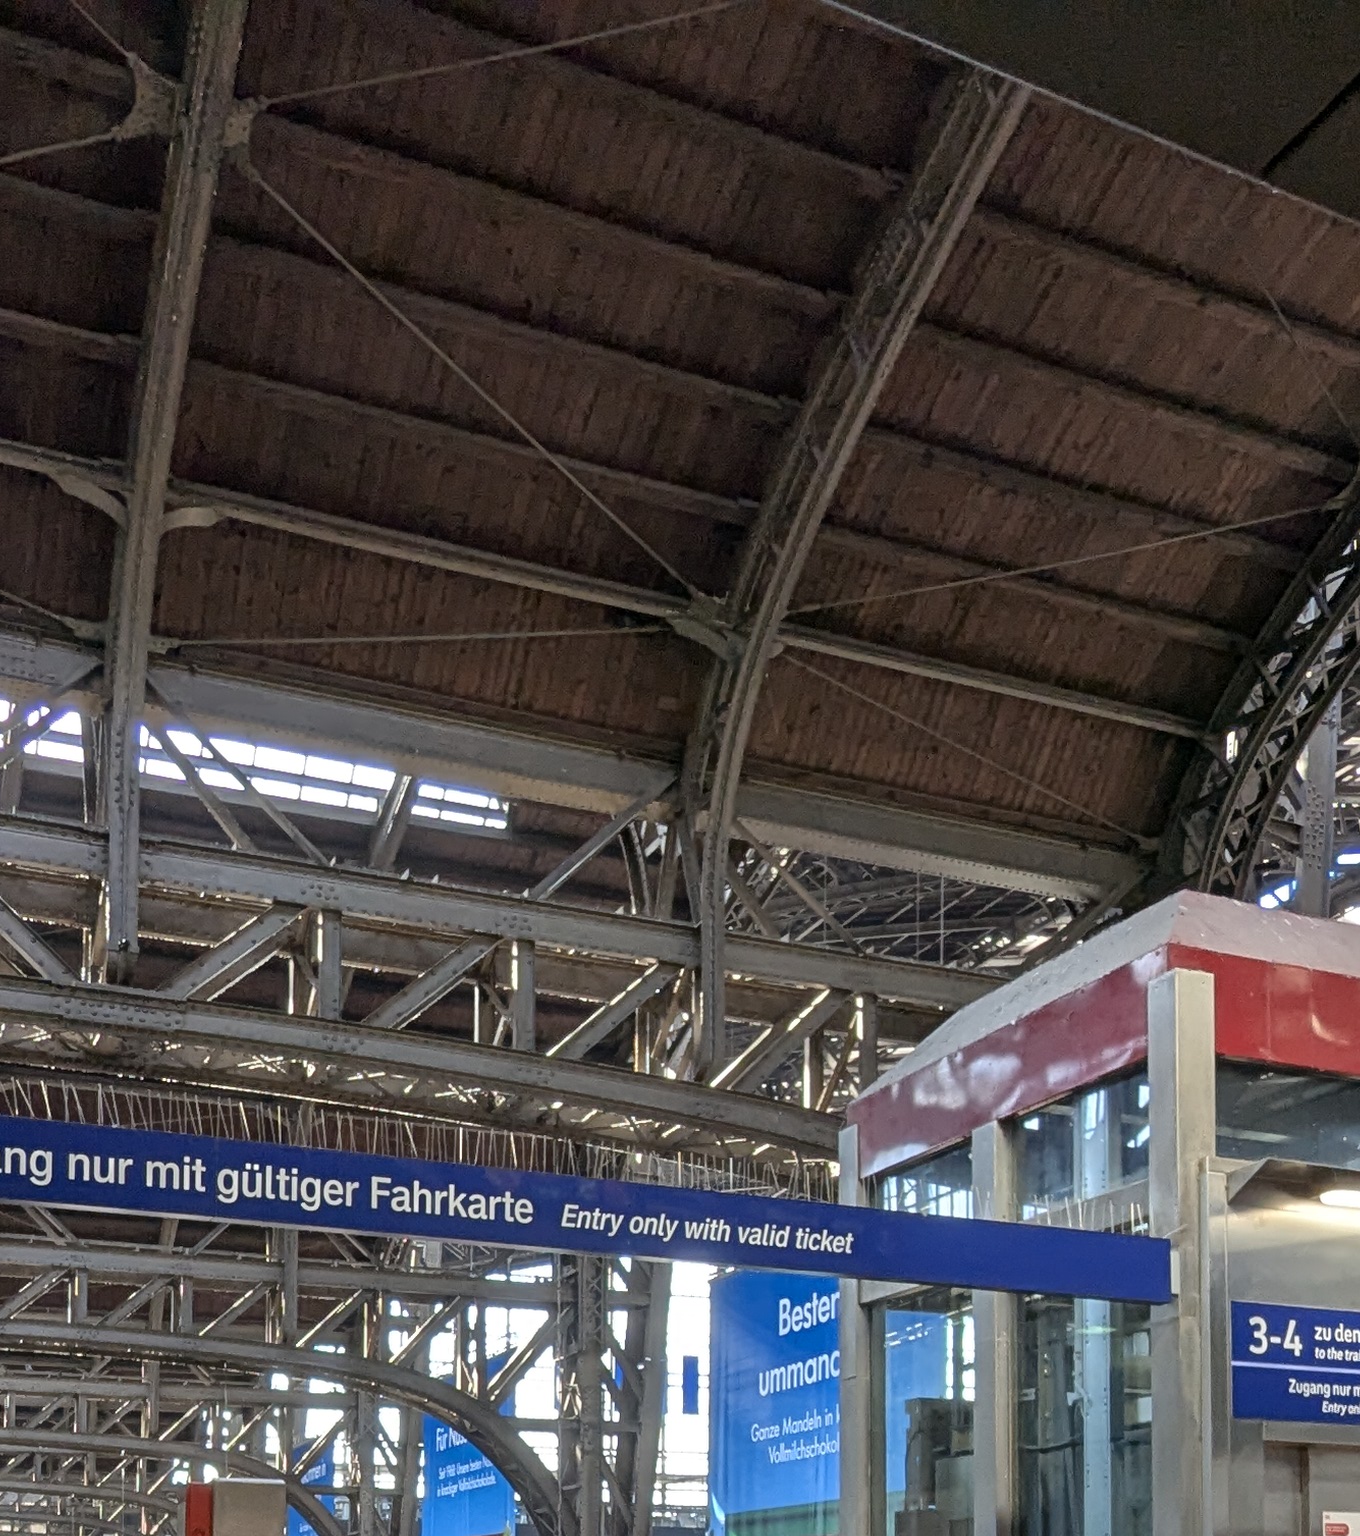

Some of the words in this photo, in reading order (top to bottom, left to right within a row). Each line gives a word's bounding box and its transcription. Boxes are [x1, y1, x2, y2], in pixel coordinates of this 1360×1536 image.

[67, 1151, 128, 1185] nur
[145, 1155, 206, 1193] mit
[216, 1166, 359, 1212] gültiger
[370, 1176, 534, 1225] Fahrkarte
[561, 1204, 623, 1237] Entry
[629, 1212, 678, 1242] only
[685, 1217, 730, 1242] with
[738, 1223, 789, 1248] valid
[795, 1228, 854, 1254] ticket
[1248, 1316, 1303, 1357] 3-4
[1314, 1327, 1331, 1342] zu
[1314, 1347, 1326, 1359] to
[1326, 1347, 1343, 1361] the
[1288, 1378, 1331, 1398] Zugang
[1332, 1383, 1352, 1396] nur
[1322, 1400, 1347, 1416] Entry
[751, 1423, 780, 1442] Ganze
[782, 1408, 821, 1436] Mandeln
[824, 1408, 833, 1426] in
[436, 1427, 448, 1452] Für
